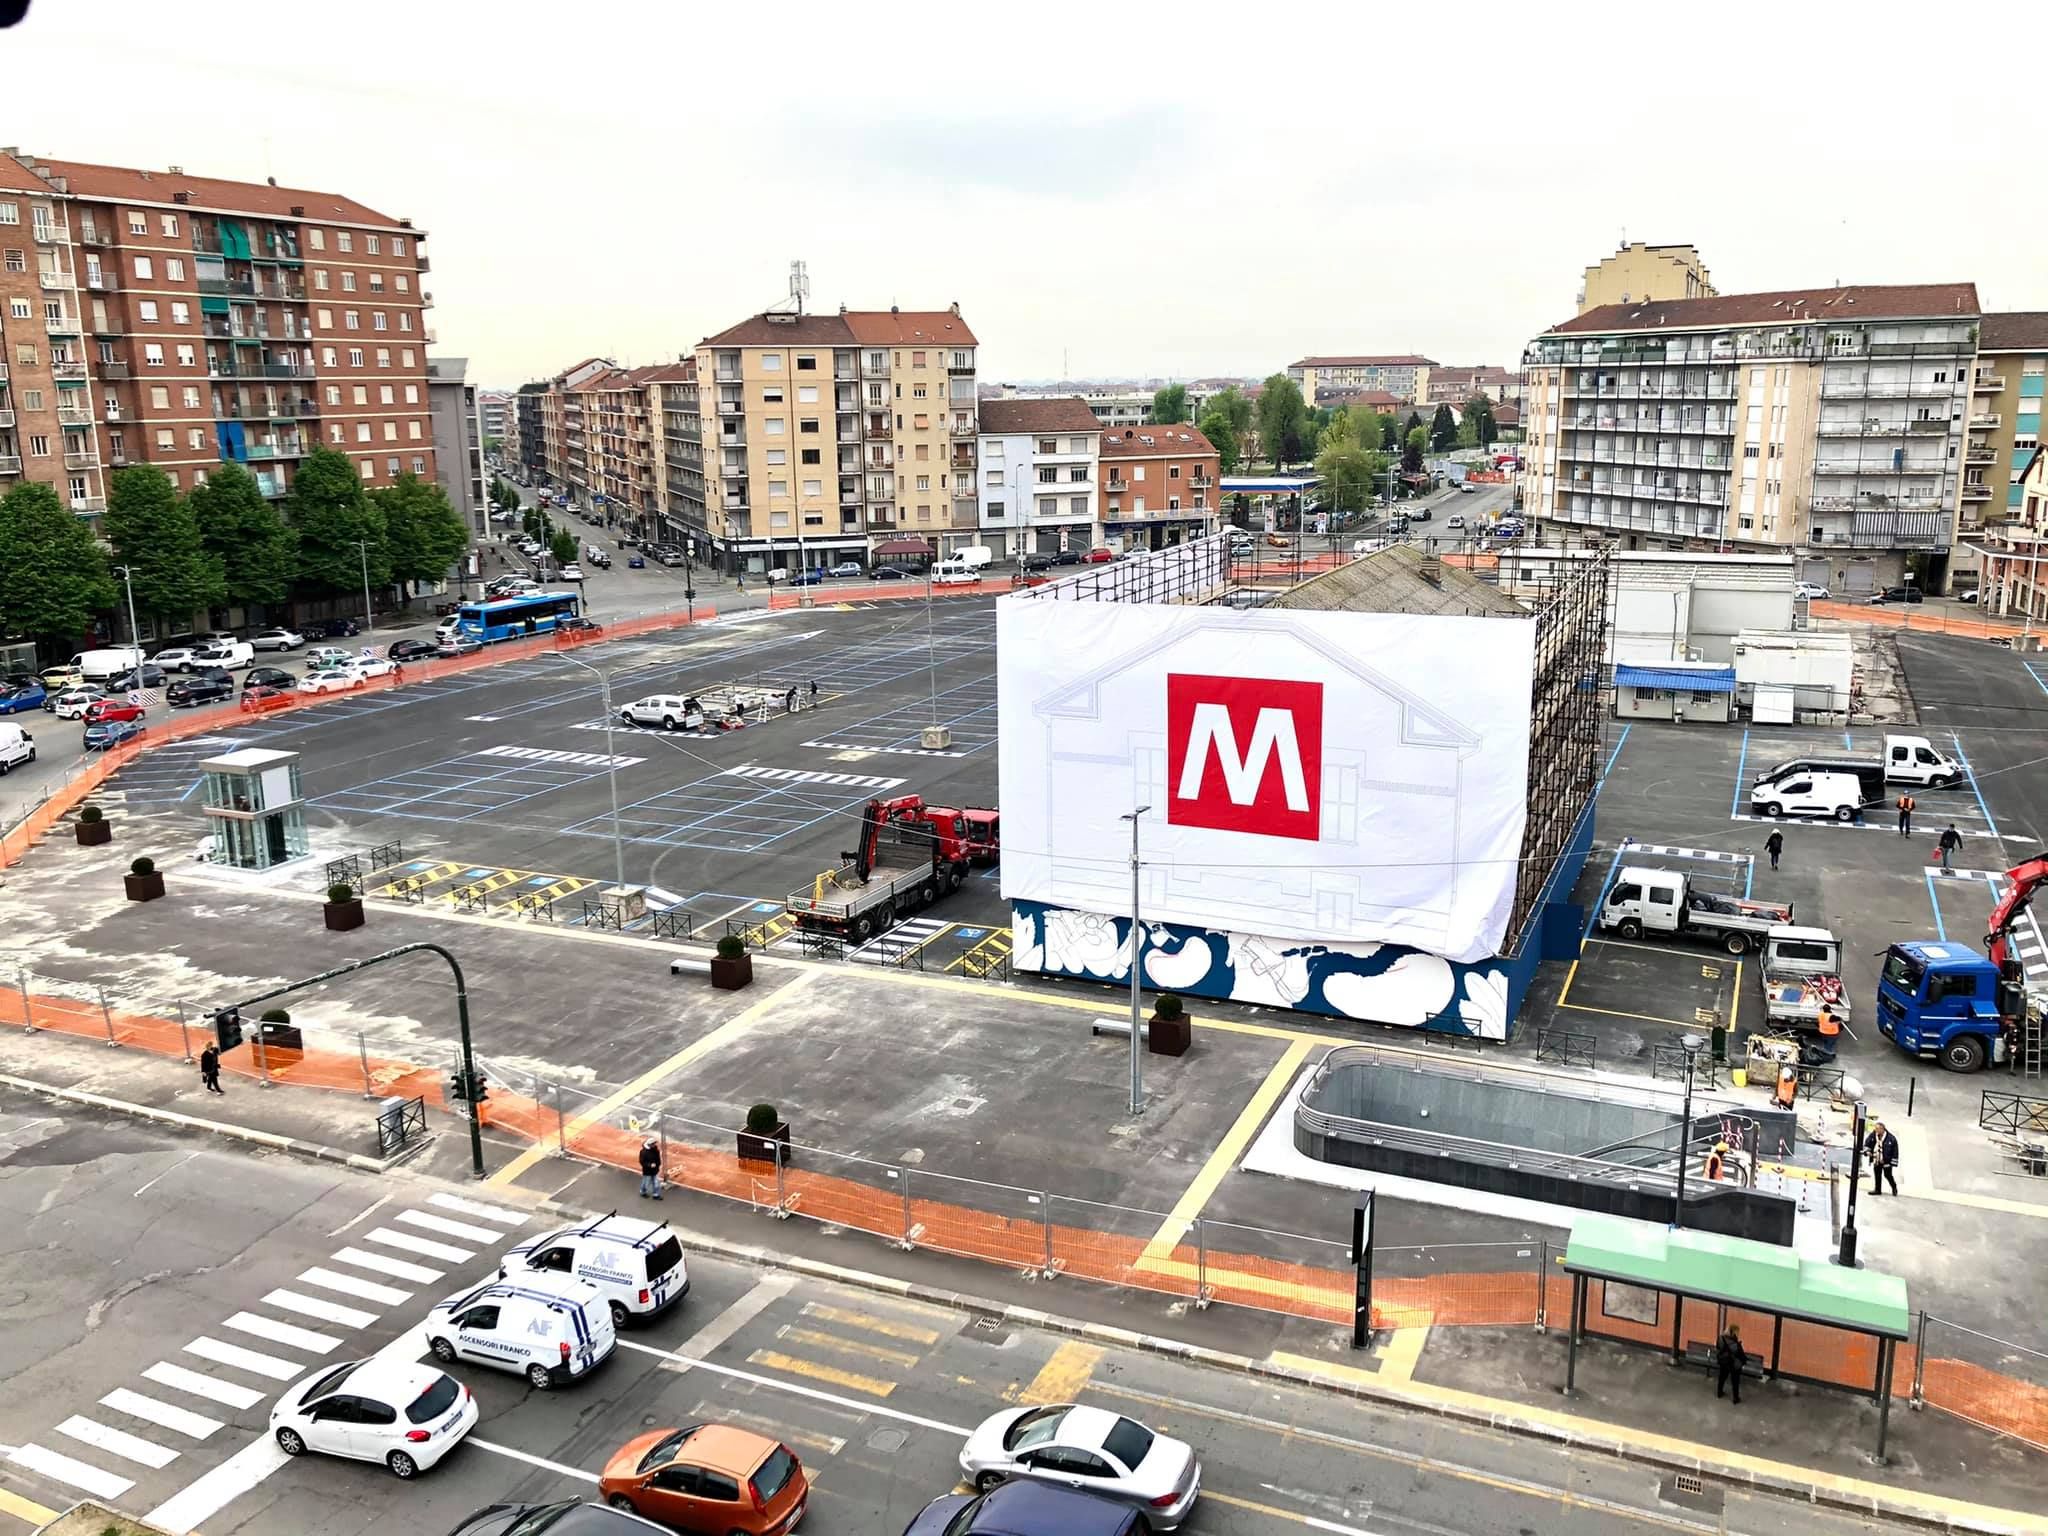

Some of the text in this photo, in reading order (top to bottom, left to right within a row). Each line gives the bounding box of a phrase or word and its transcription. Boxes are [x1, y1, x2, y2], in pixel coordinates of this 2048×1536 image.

[1177, 702, 1310, 813] M
[459, 1334, 531, 1357] ASCENSORI FRANCO
